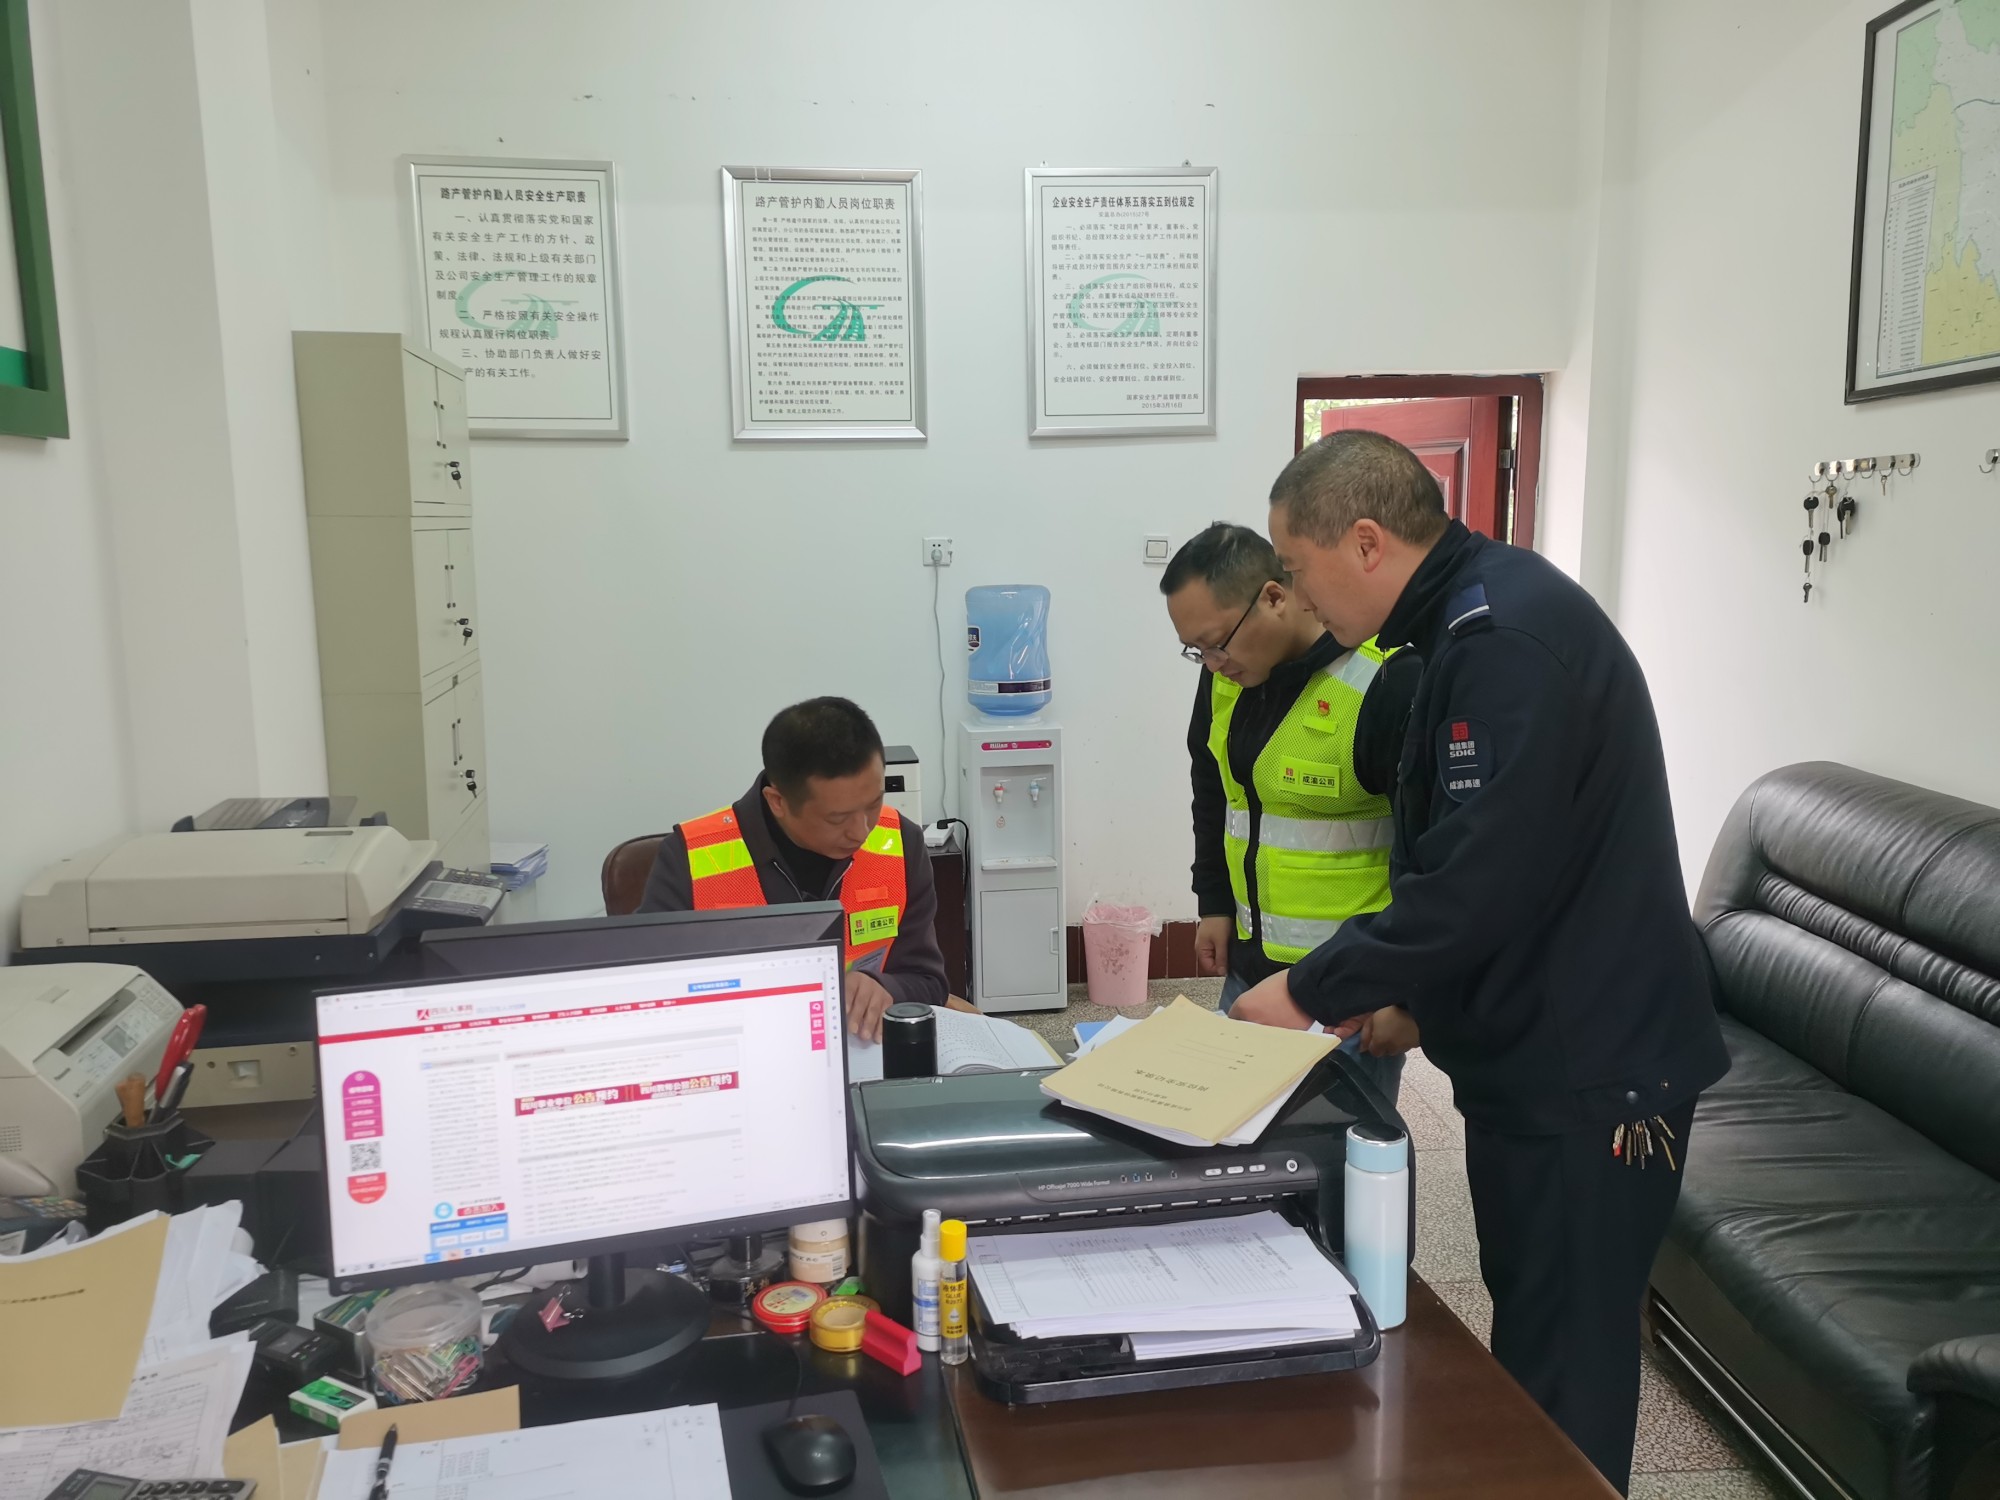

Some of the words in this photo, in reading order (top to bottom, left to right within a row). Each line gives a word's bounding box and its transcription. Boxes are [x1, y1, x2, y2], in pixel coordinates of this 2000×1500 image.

[440, 187, 587, 204] 路产管护内勤人员安全生产职责
[1052, 196, 1195, 208] 企业安全生产责任体系五落实五到位规定
[755, 196, 896, 210] 路产管护内勤人员岗位职责
[454, 212, 595, 226] 一、认真贯彻落实党和国家
[432, 231, 596, 246] 有关安全生产工作的方针、政
[433, 250, 597, 265] 策、法律、法规和上级有关部门
[435, 270, 598, 284] 及公司安全生产管理工作的规章
[459, 309, 600, 323] 二、严格按照有关安全操作
[461, 348, 602, 361] 三、协助部门负责人做好安
[1449, 749, 1475, 758] SDIG
[1302, 776, 1335, 786] 成渝公司
[1449, 779, 1481, 790] 成渝高速
